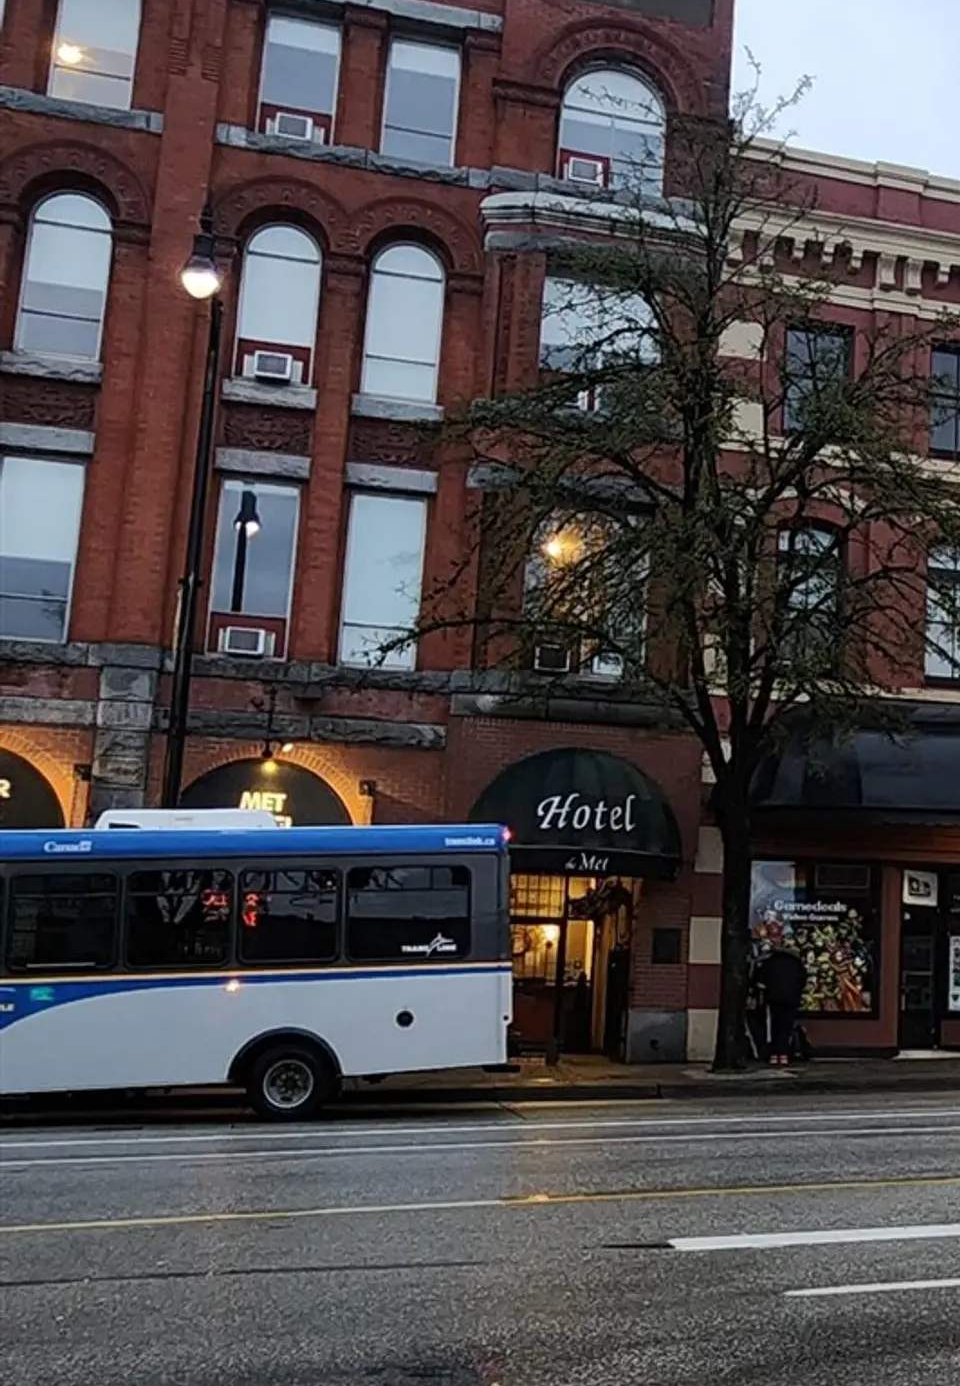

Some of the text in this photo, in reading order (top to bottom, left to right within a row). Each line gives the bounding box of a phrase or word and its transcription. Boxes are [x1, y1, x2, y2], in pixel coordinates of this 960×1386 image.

[240, 791, 287, 812] MET
[537, 792, 636, 831] Hotel
[44, 841, 92, 852] Canada
[774, 900, 847, 912] Gamedeals
